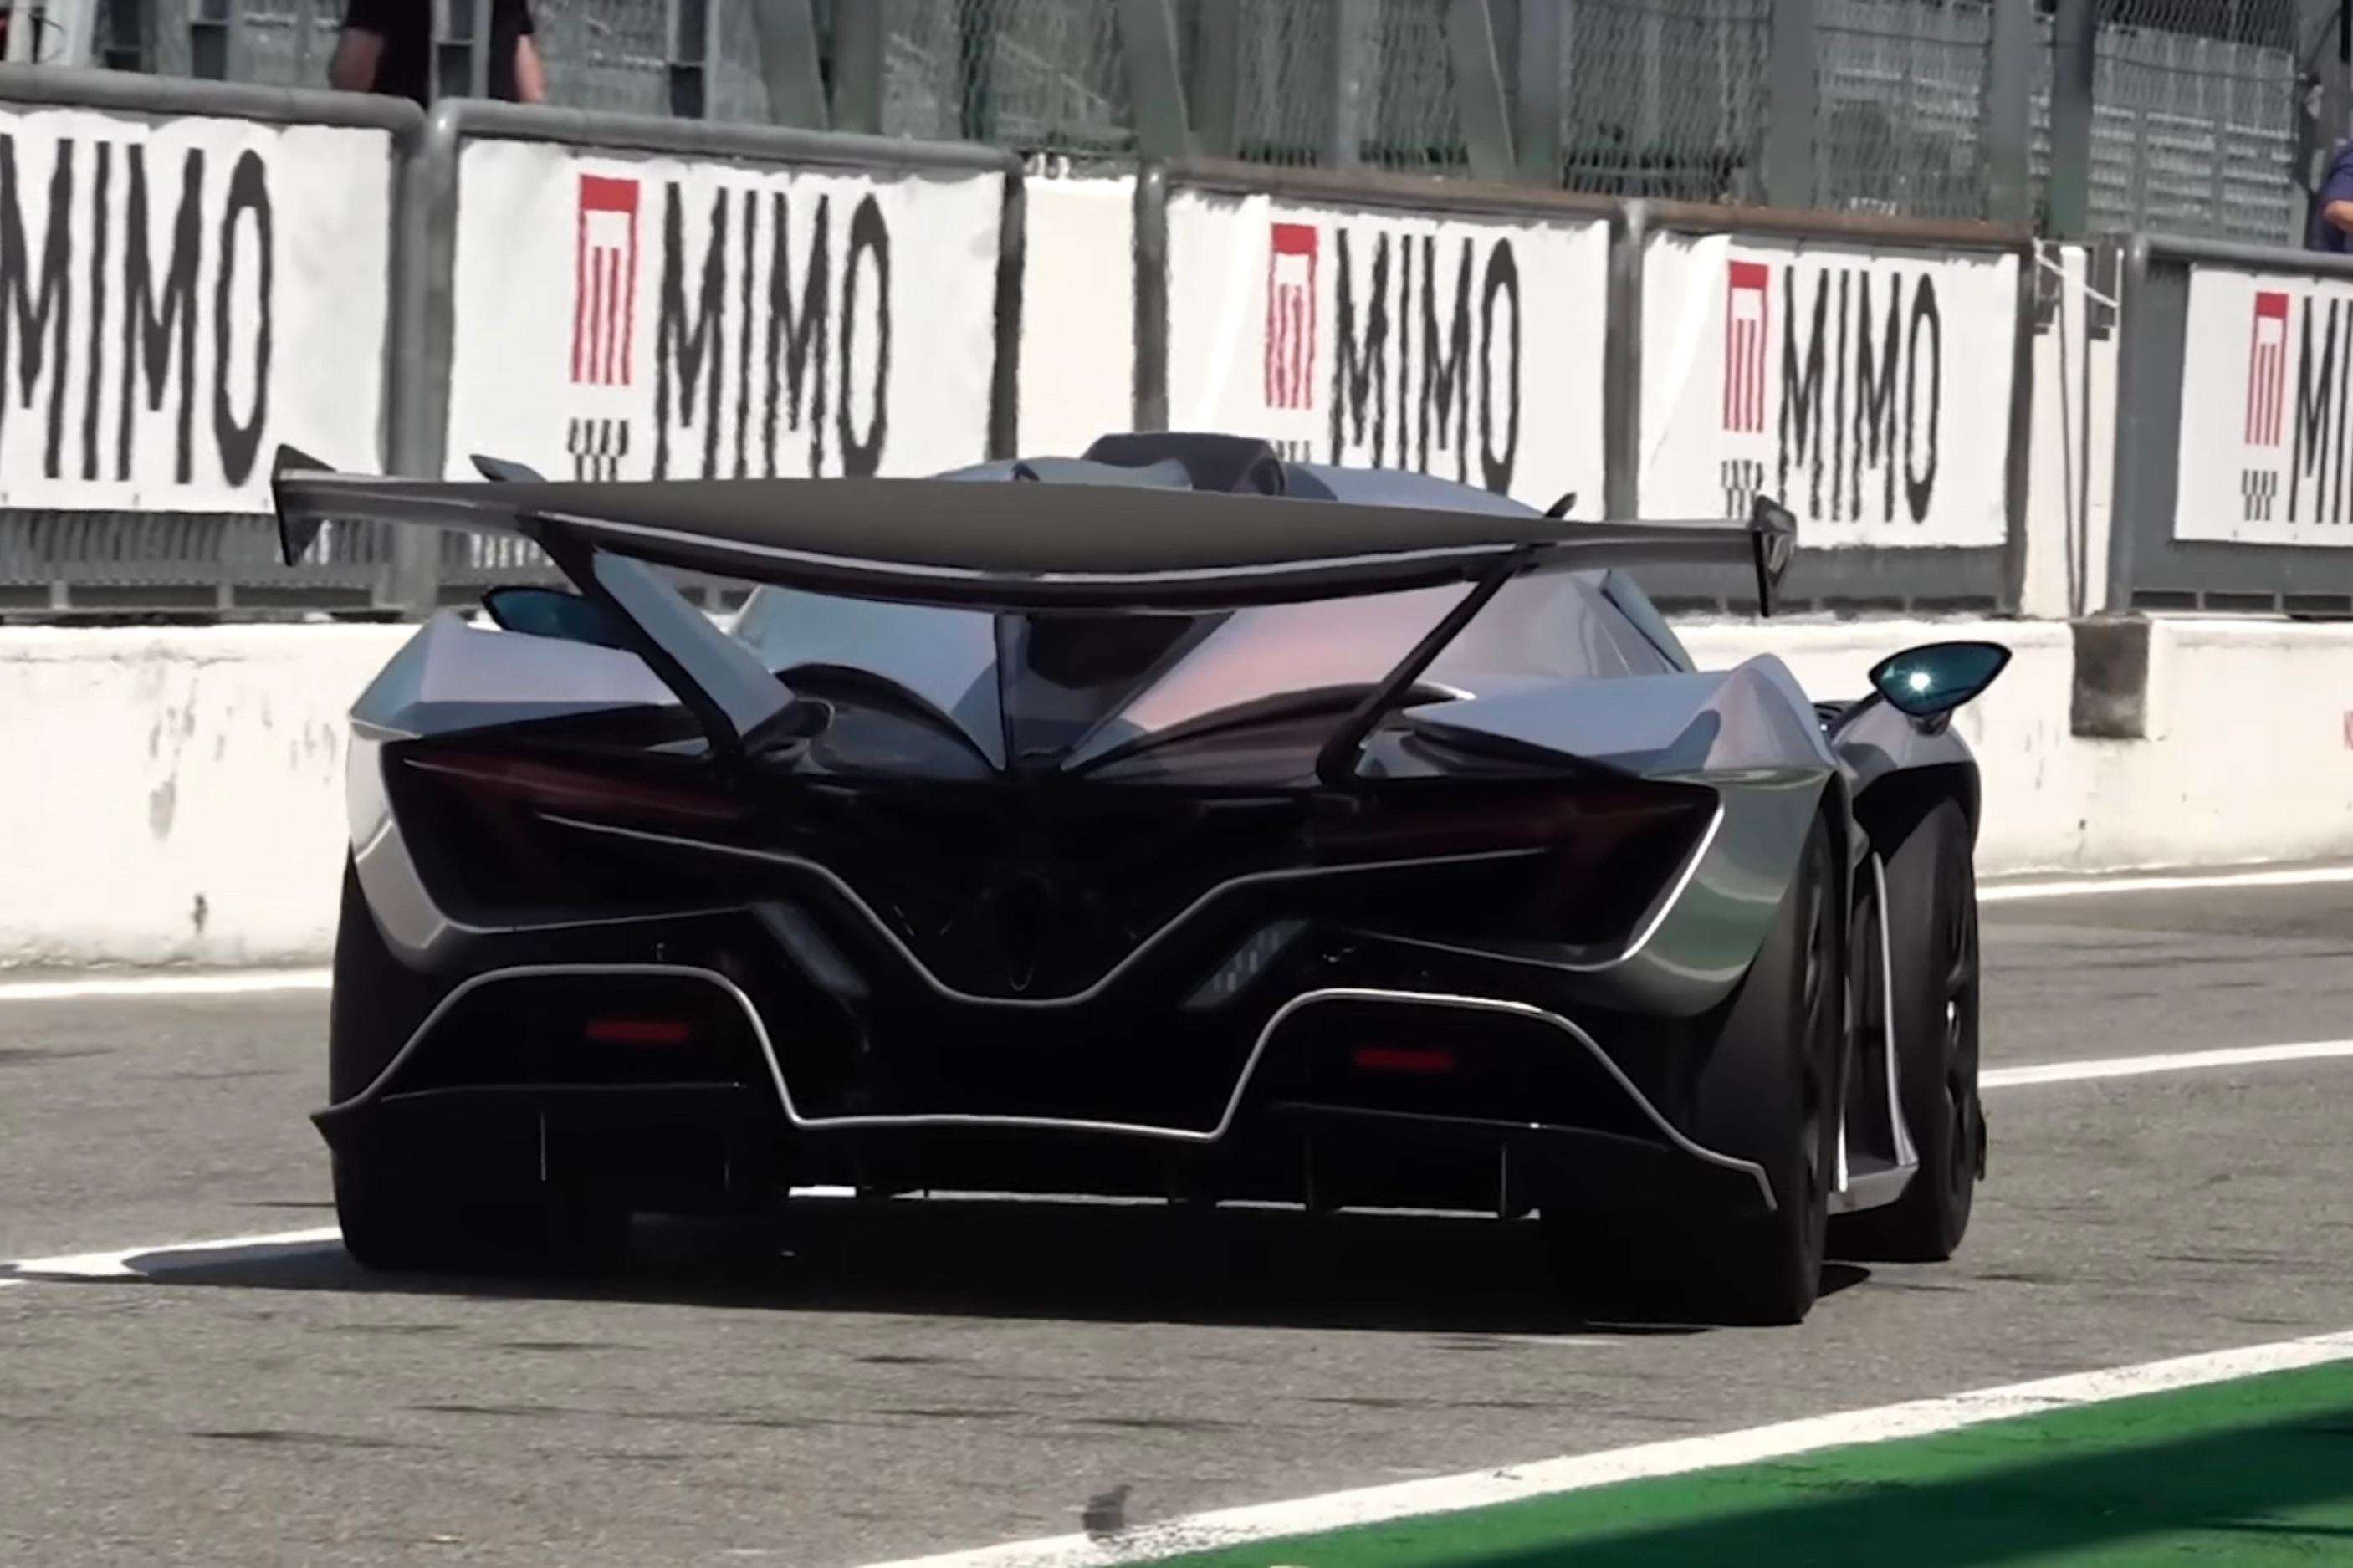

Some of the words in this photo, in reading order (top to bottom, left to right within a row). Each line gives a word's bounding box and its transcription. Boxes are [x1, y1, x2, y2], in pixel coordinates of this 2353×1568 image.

[0, 133, 272, 488] MIMO
[652, 181, 890, 479] MIMO
[1328, 228, 1519, 494] MIMO
[1778, 265, 1941, 524] MIMO
[2289, 296, 2353, 524] MI
